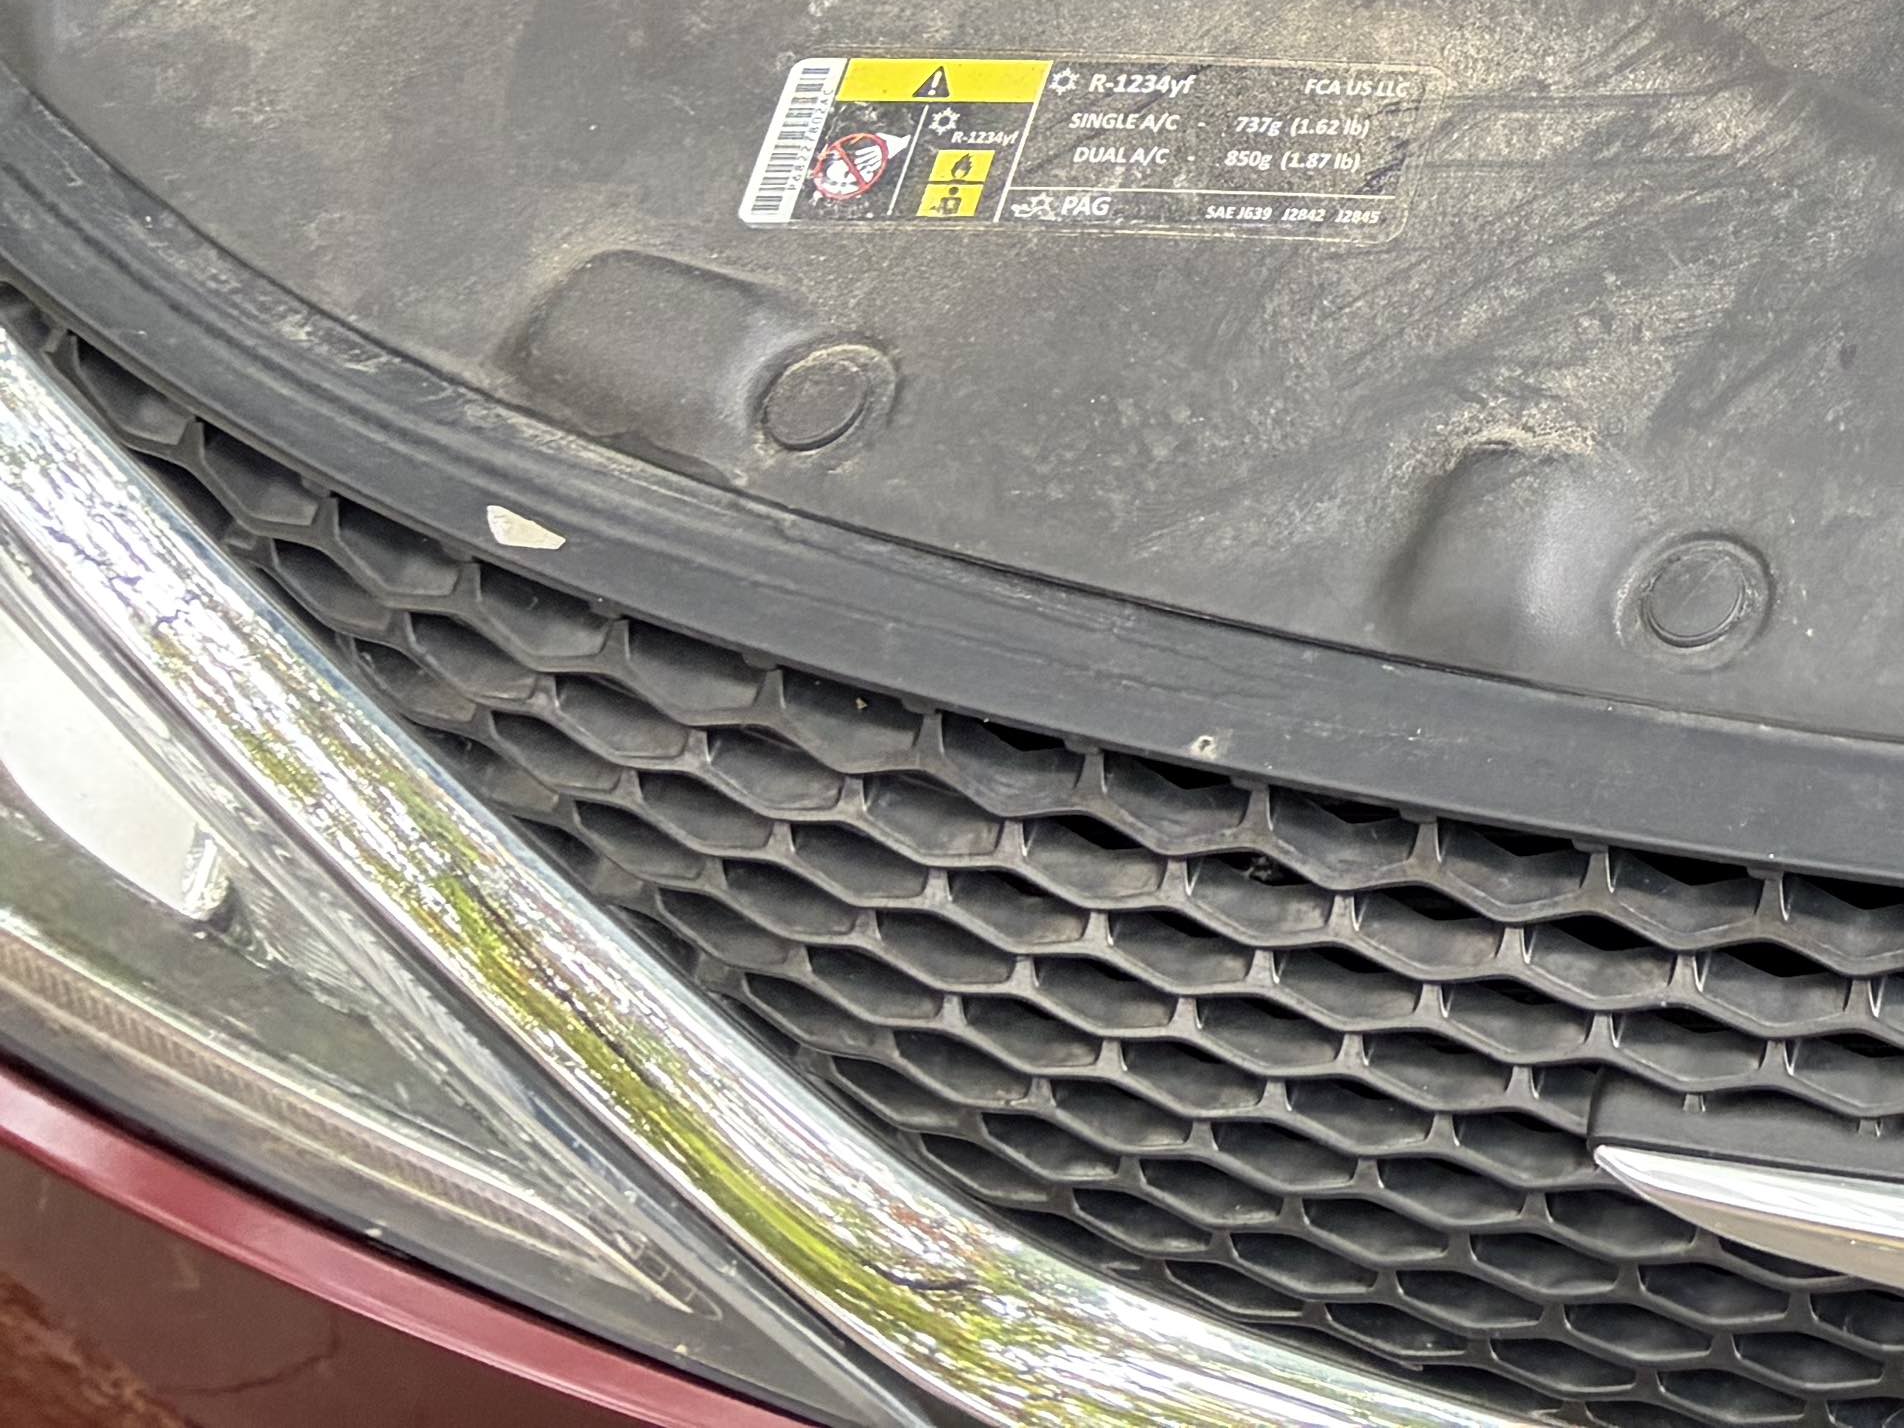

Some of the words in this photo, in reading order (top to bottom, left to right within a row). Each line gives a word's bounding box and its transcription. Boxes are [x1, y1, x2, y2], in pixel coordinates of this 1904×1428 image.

[1088, 73, 1197, 97] R-1234yf
[1305, 78, 1341, 95] FCA
[1348, 80, 1373, 96] US
[1377, 80, 1410, 97] LLC
[1069, 112, 1139, 129] SINGLE
[1139, 113, 1180, 133] A/C
[1235, 116, 1283, 137] 737g
[1290, 117, 1340, 137] (1.62
[1343, 119, 1370, 139] lb)
[951, 130, 1019, 145] R-1234yf
[1073, 146, 1127, 163] DUAL
[1129, 146, 1170, 166] A/C
[1224, 150, 1272, 171] 850g
[1280, 151, 1331, 171] (1.87
[1334, 153, 1361, 173] lb)
[1060, 195, 1112, 216] PAG
[1205, 205, 1236, 219] SAE
[1236, 206, 1273, 221] J639
